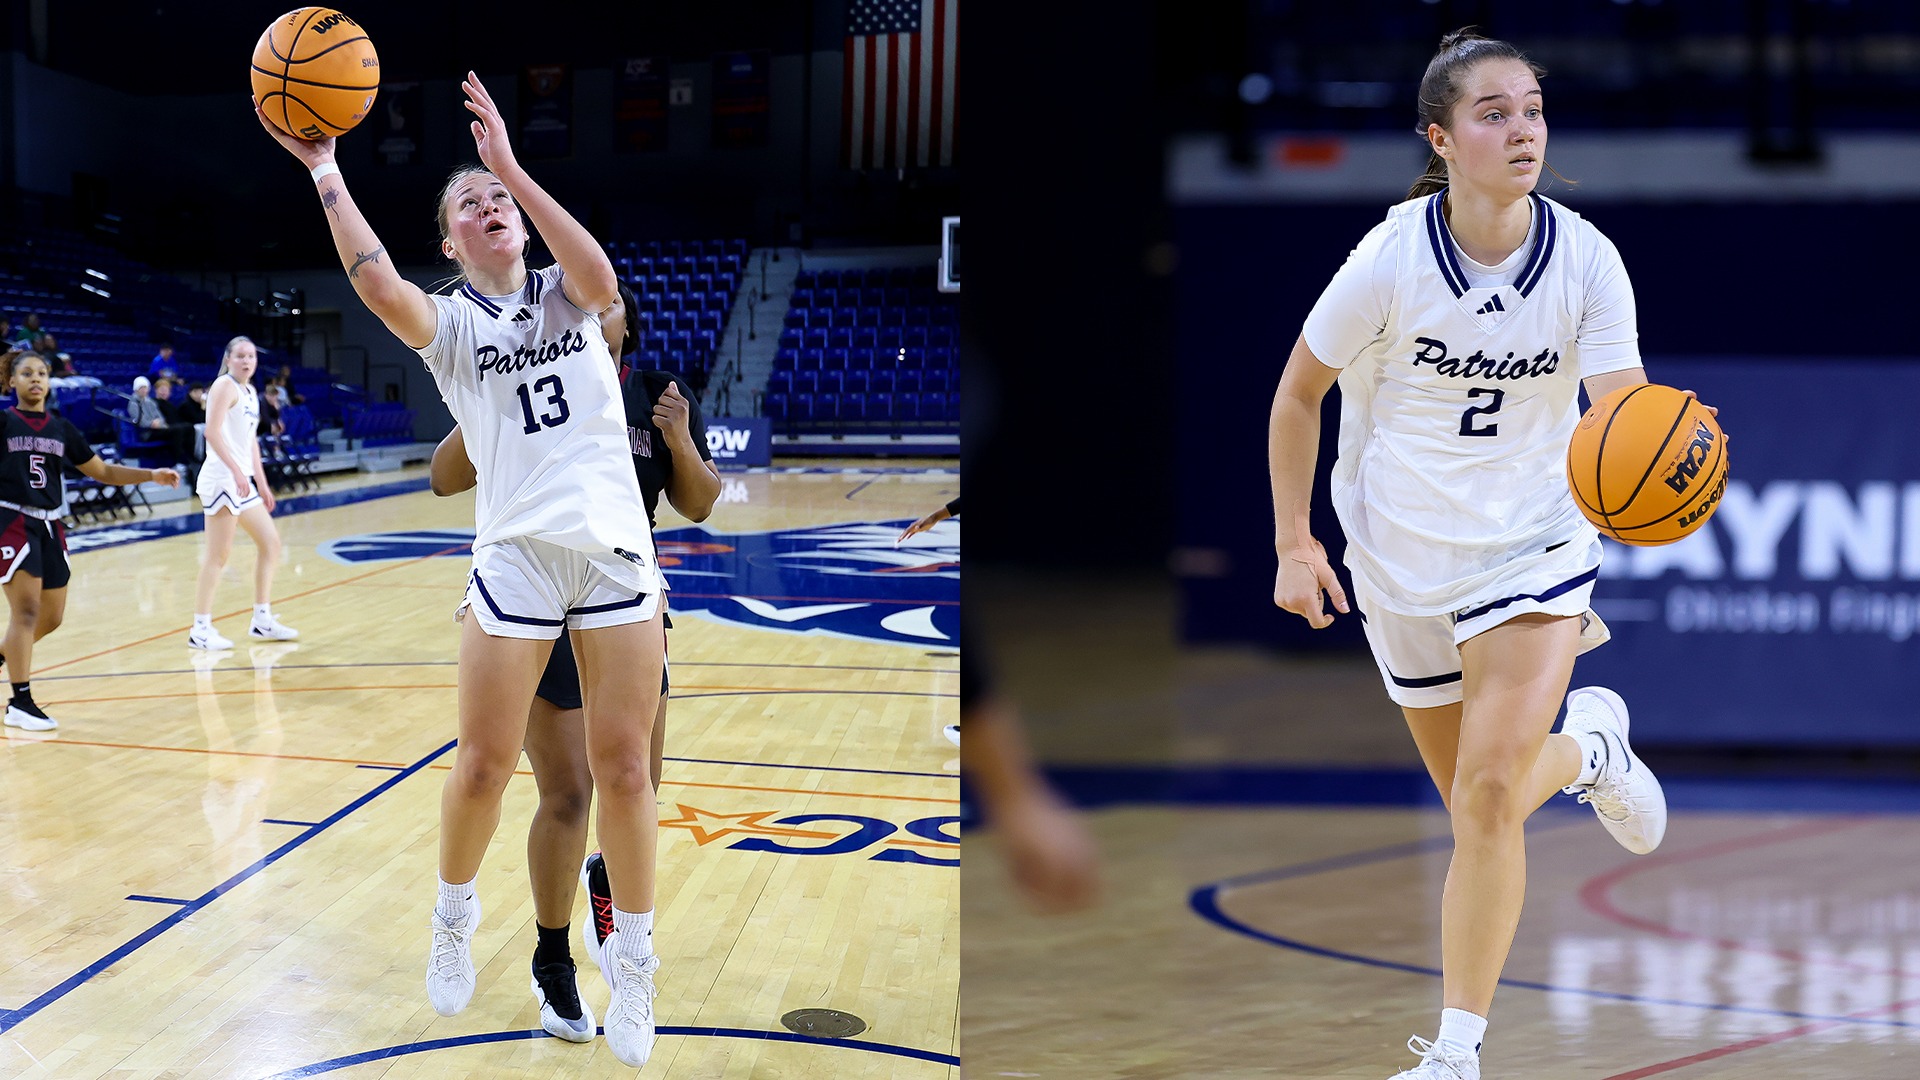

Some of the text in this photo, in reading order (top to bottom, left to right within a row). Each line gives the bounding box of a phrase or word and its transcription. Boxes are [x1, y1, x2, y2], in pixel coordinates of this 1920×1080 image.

[477, 329, 588, 382] Patriots
[1412, 336, 1560, 380] Patriots
[516, 374, 571, 435] 13
[1458, 387, 1506, 437] 2
[29, 454, 48, 489] 5
[1664, 420, 1715, 495] NCAA
[1831, 587, 1920, 642] Fing
